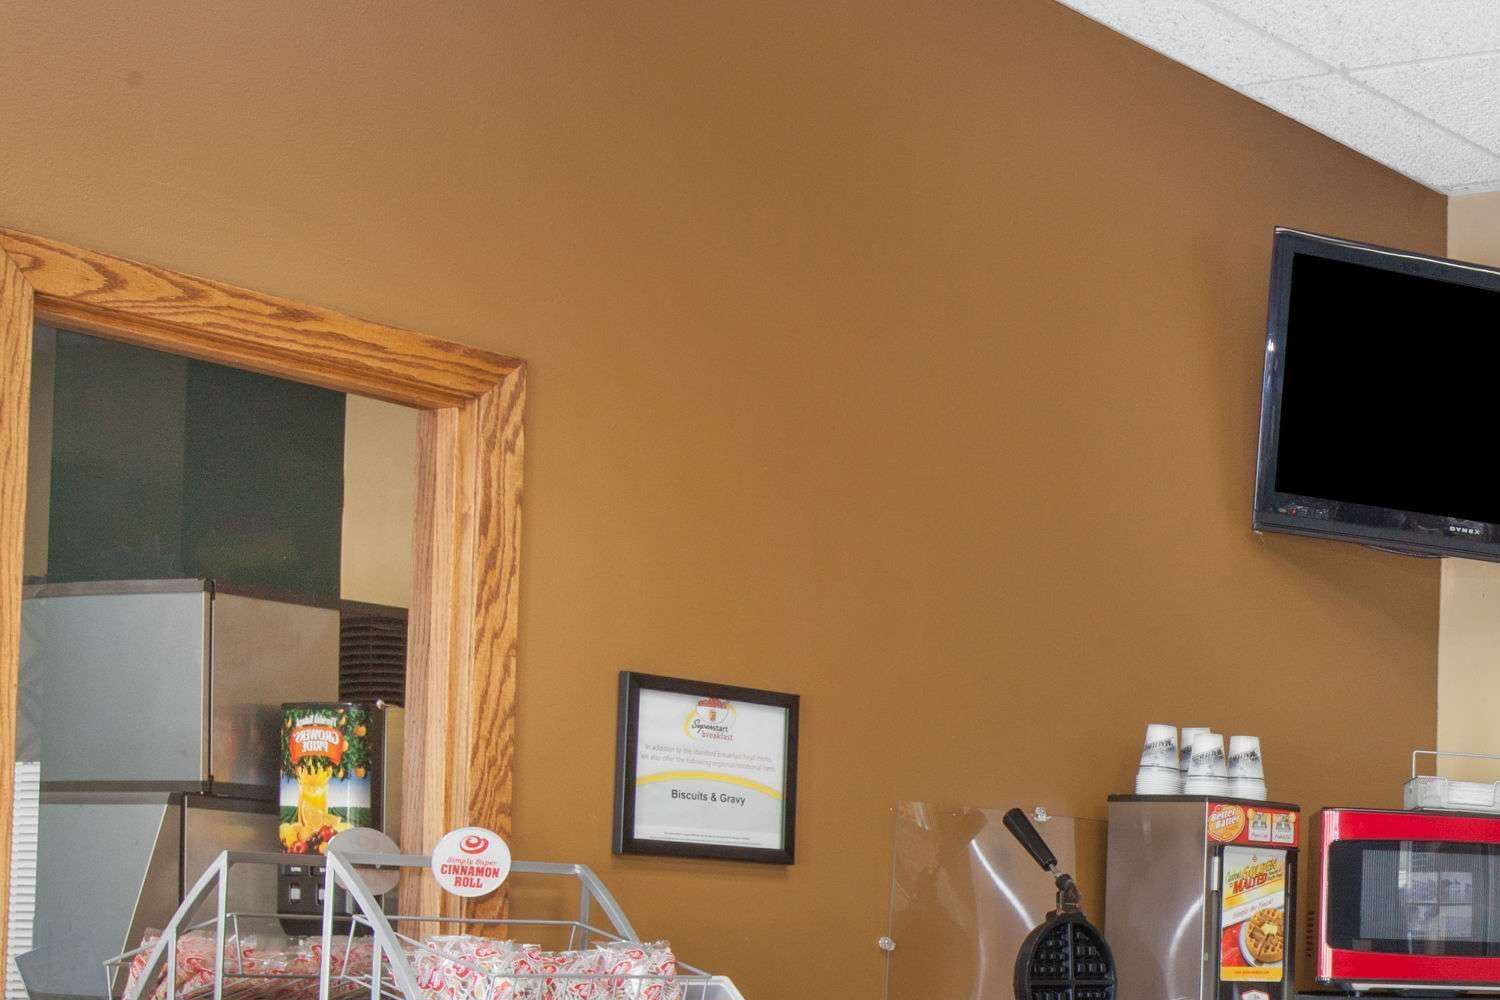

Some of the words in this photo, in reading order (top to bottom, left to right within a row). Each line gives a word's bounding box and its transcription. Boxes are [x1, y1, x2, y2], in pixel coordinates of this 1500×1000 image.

[671, 788, 708, 801] Biscuits
[710, 792, 717, 802] &
[719, 793, 746, 807] Gravy
[440, 864, 500, 878] CINNAMON
[454, 876, 483, 888] ROLL
